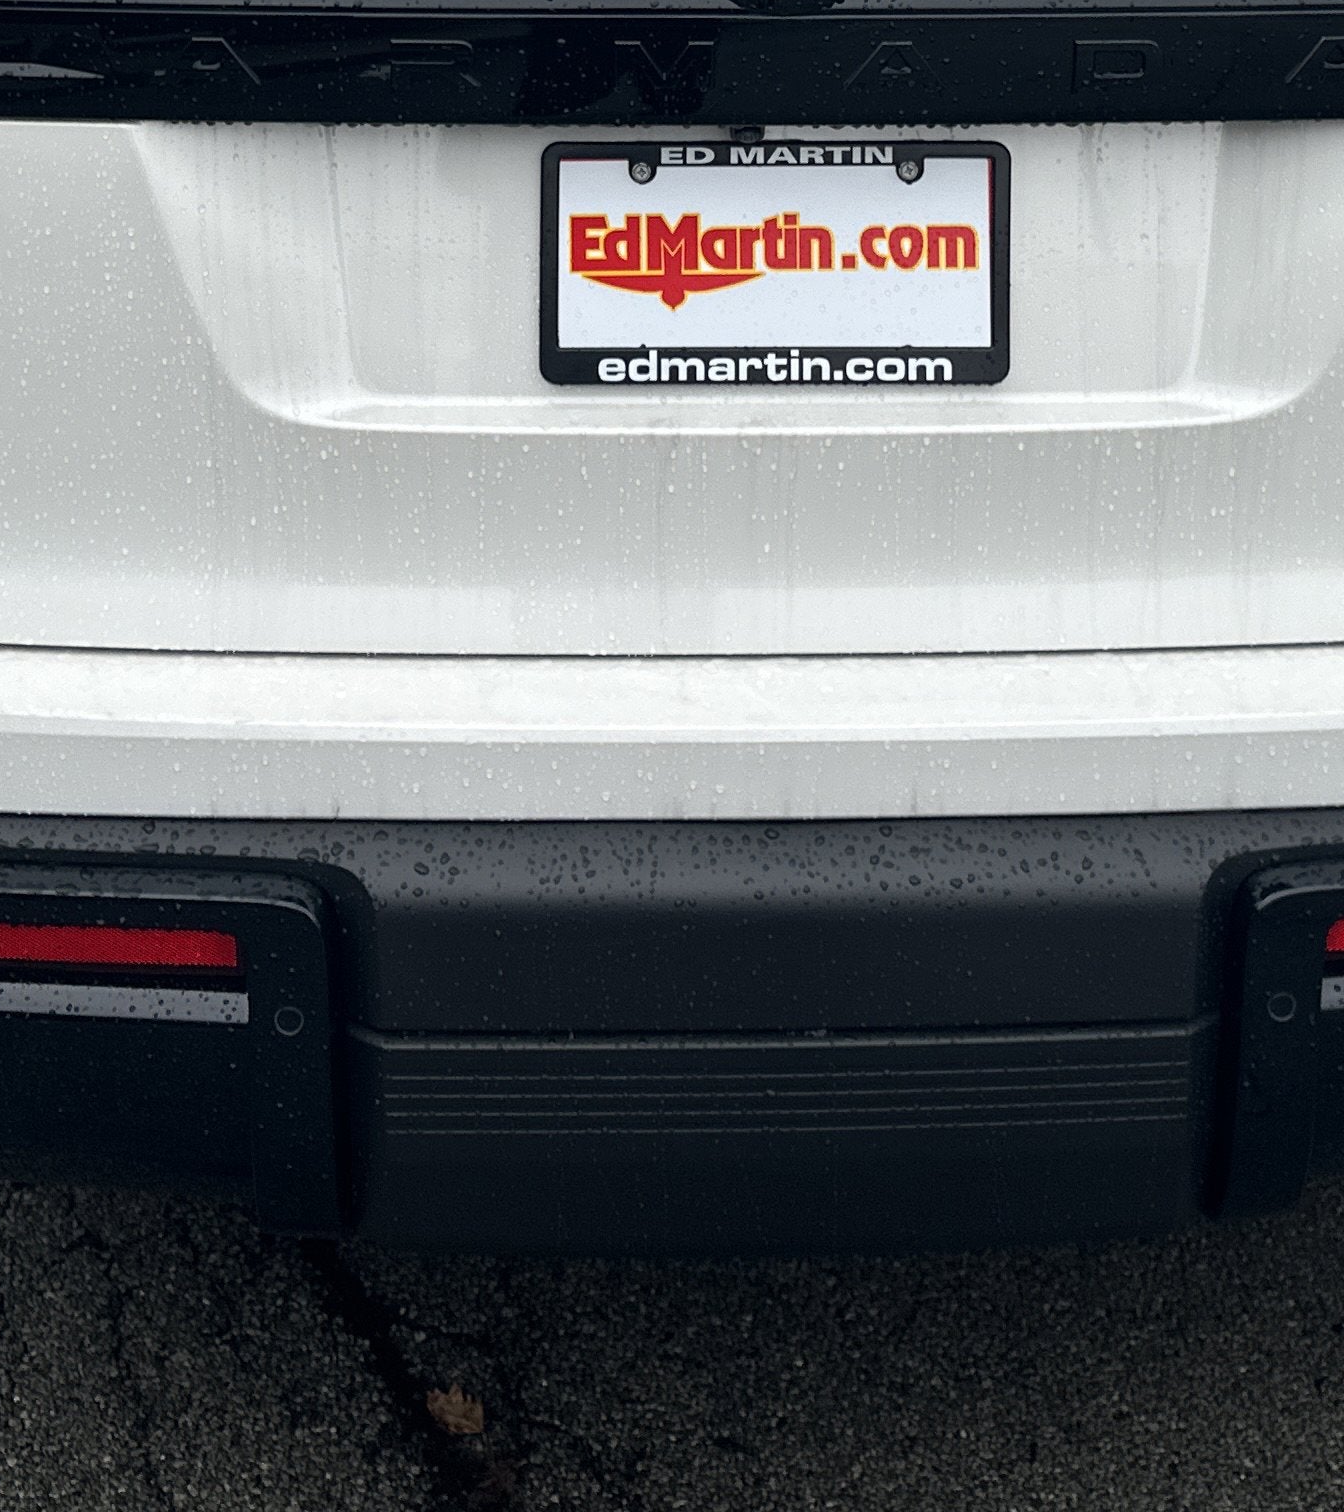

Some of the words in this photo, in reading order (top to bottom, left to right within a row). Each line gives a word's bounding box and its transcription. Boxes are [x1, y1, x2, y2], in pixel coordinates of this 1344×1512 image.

[660, 147, 716, 165] ED
[730, 146, 894, 165] MARTIN
[569, 212, 980, 274] EdMartin.com
[597, 350, 953, 383] edmartin.com
